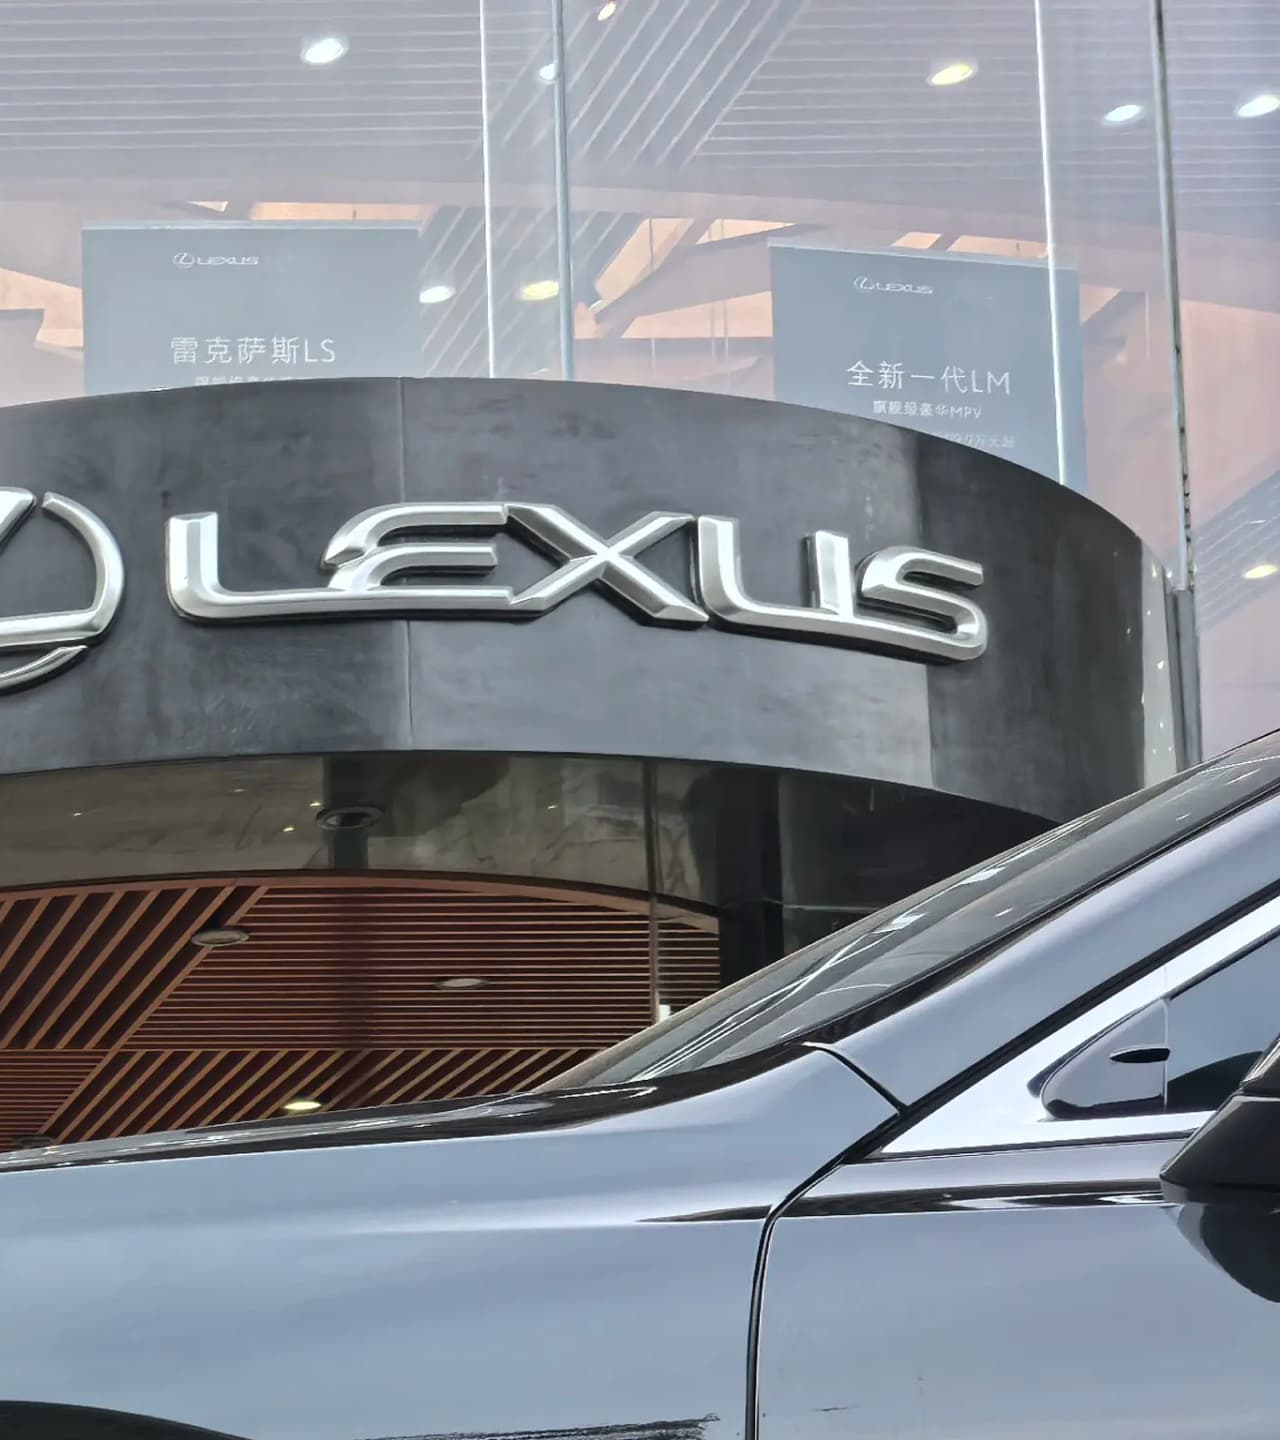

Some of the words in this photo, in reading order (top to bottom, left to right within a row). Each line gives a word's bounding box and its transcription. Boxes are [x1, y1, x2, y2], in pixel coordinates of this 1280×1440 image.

[196, 255, 259, 265] LEXUS
[170, 335, 337, 365] 雷克萨斯LS
[846, 360, 1011, 395] 全新一代LM
[167, 501, 987, 664] LEXUS
